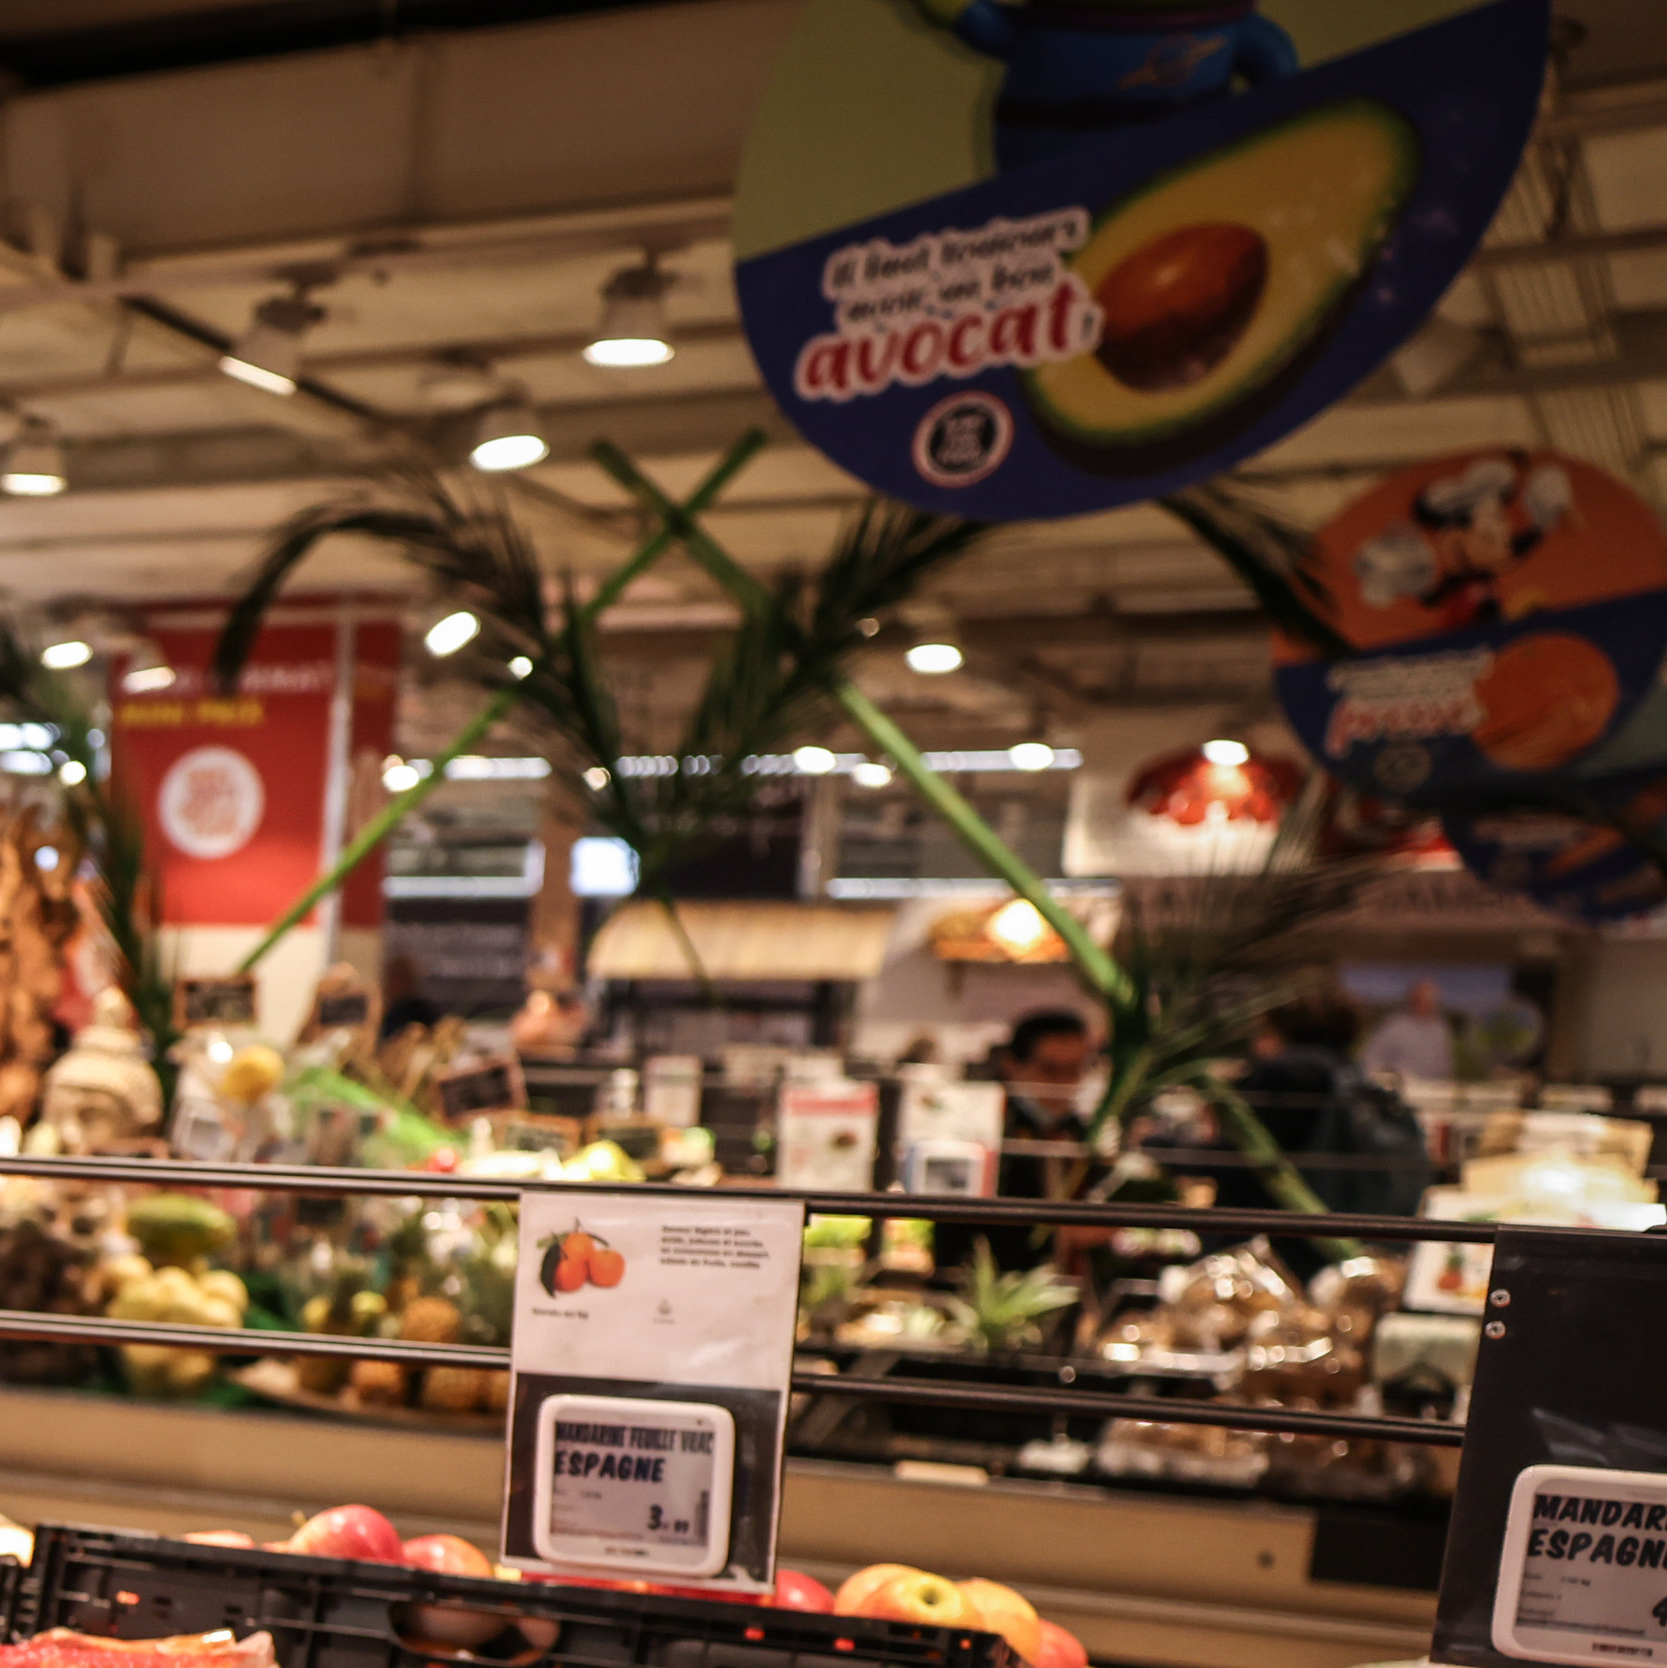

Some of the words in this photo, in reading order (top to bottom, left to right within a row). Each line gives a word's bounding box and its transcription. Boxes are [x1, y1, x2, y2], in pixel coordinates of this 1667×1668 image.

[806, 279, 1078, 390] avocat
[554, 1421, 626, 1447] MANDARINE
[629, 1426, 677, 1451] FEUILLE
[680, 1430, 715, 1455] VRAC
[553, 1449, 666, 1483] ESPAGNE
[1532, 1493, 1667, 1531] MANDAR
